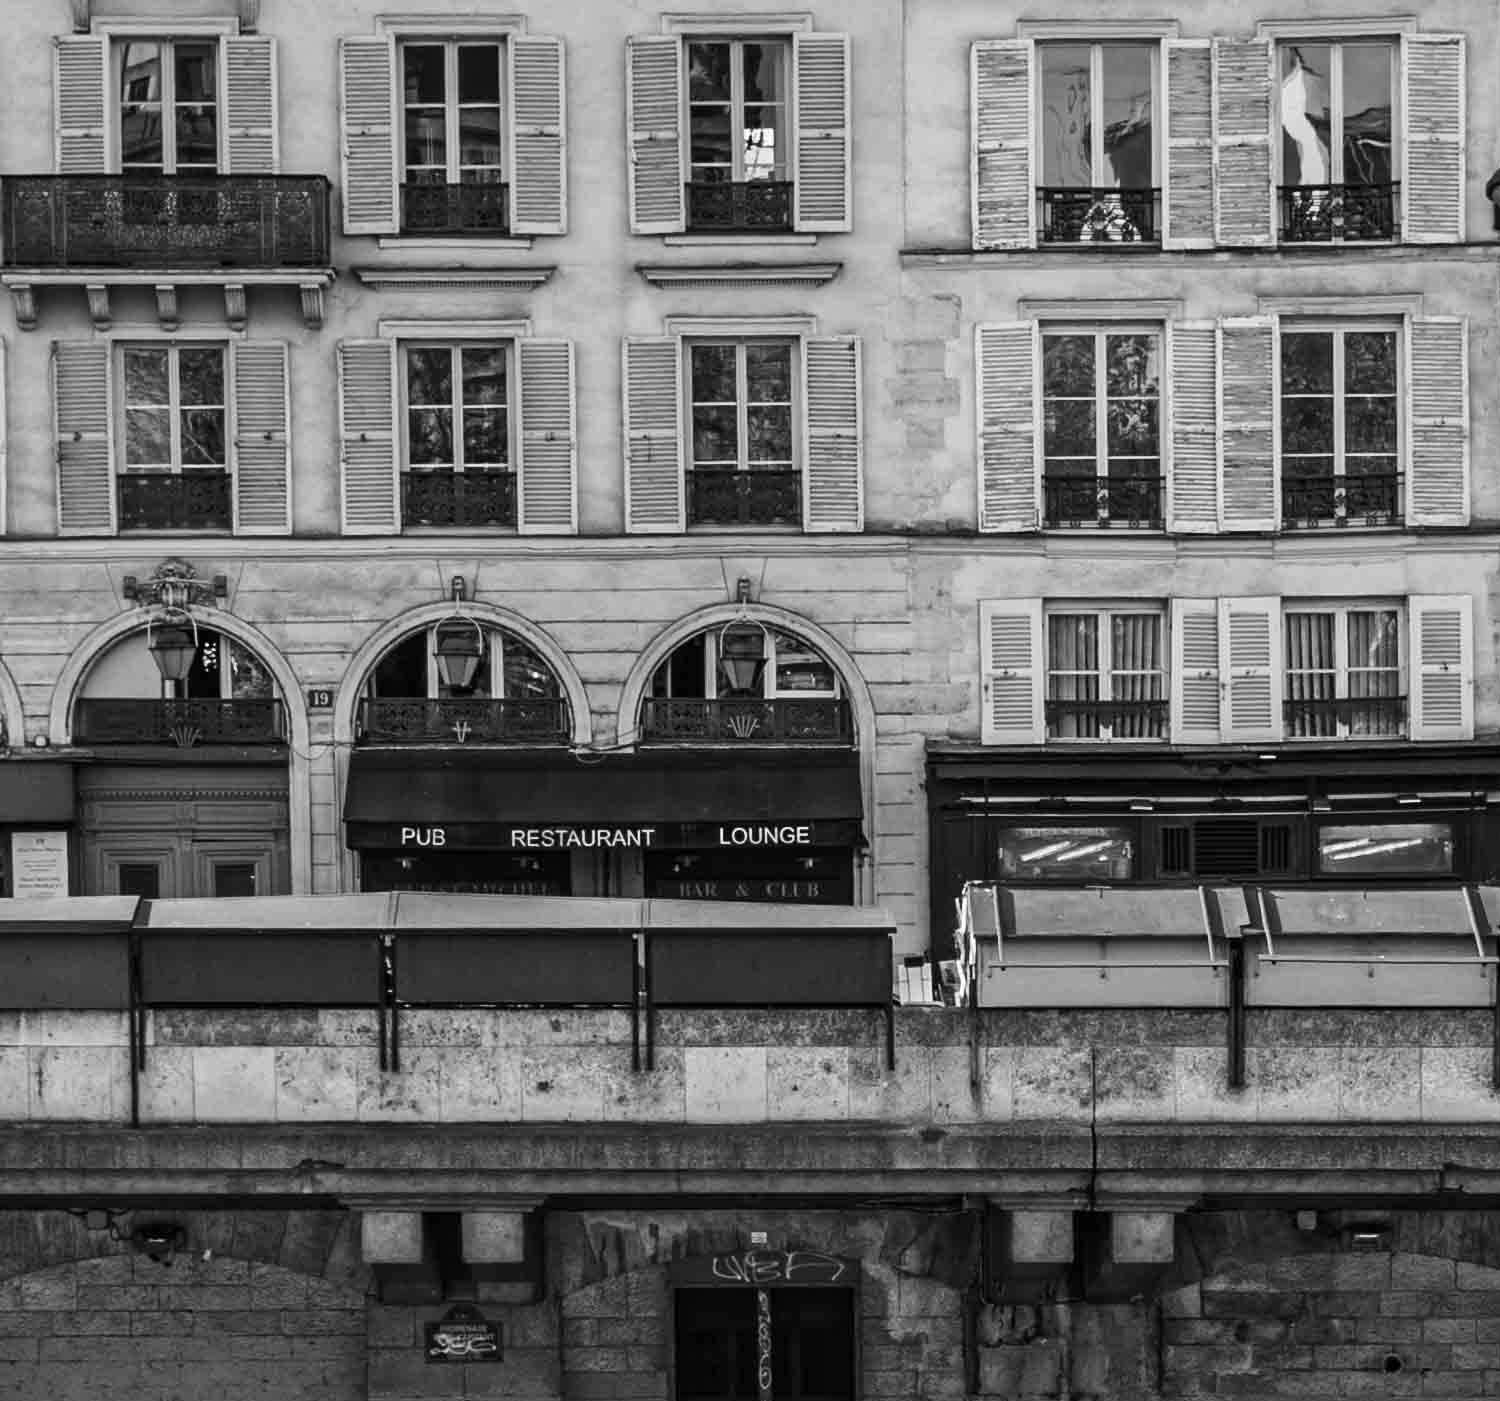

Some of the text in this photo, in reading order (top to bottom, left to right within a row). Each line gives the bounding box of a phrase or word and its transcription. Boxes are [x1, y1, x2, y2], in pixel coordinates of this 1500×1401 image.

[314, 691, 329, 705] 19
[401, 826, 811, 847] PUB RESTAURANT LOUNGE
[679, 881, 820, 898] BAR & CLUB
